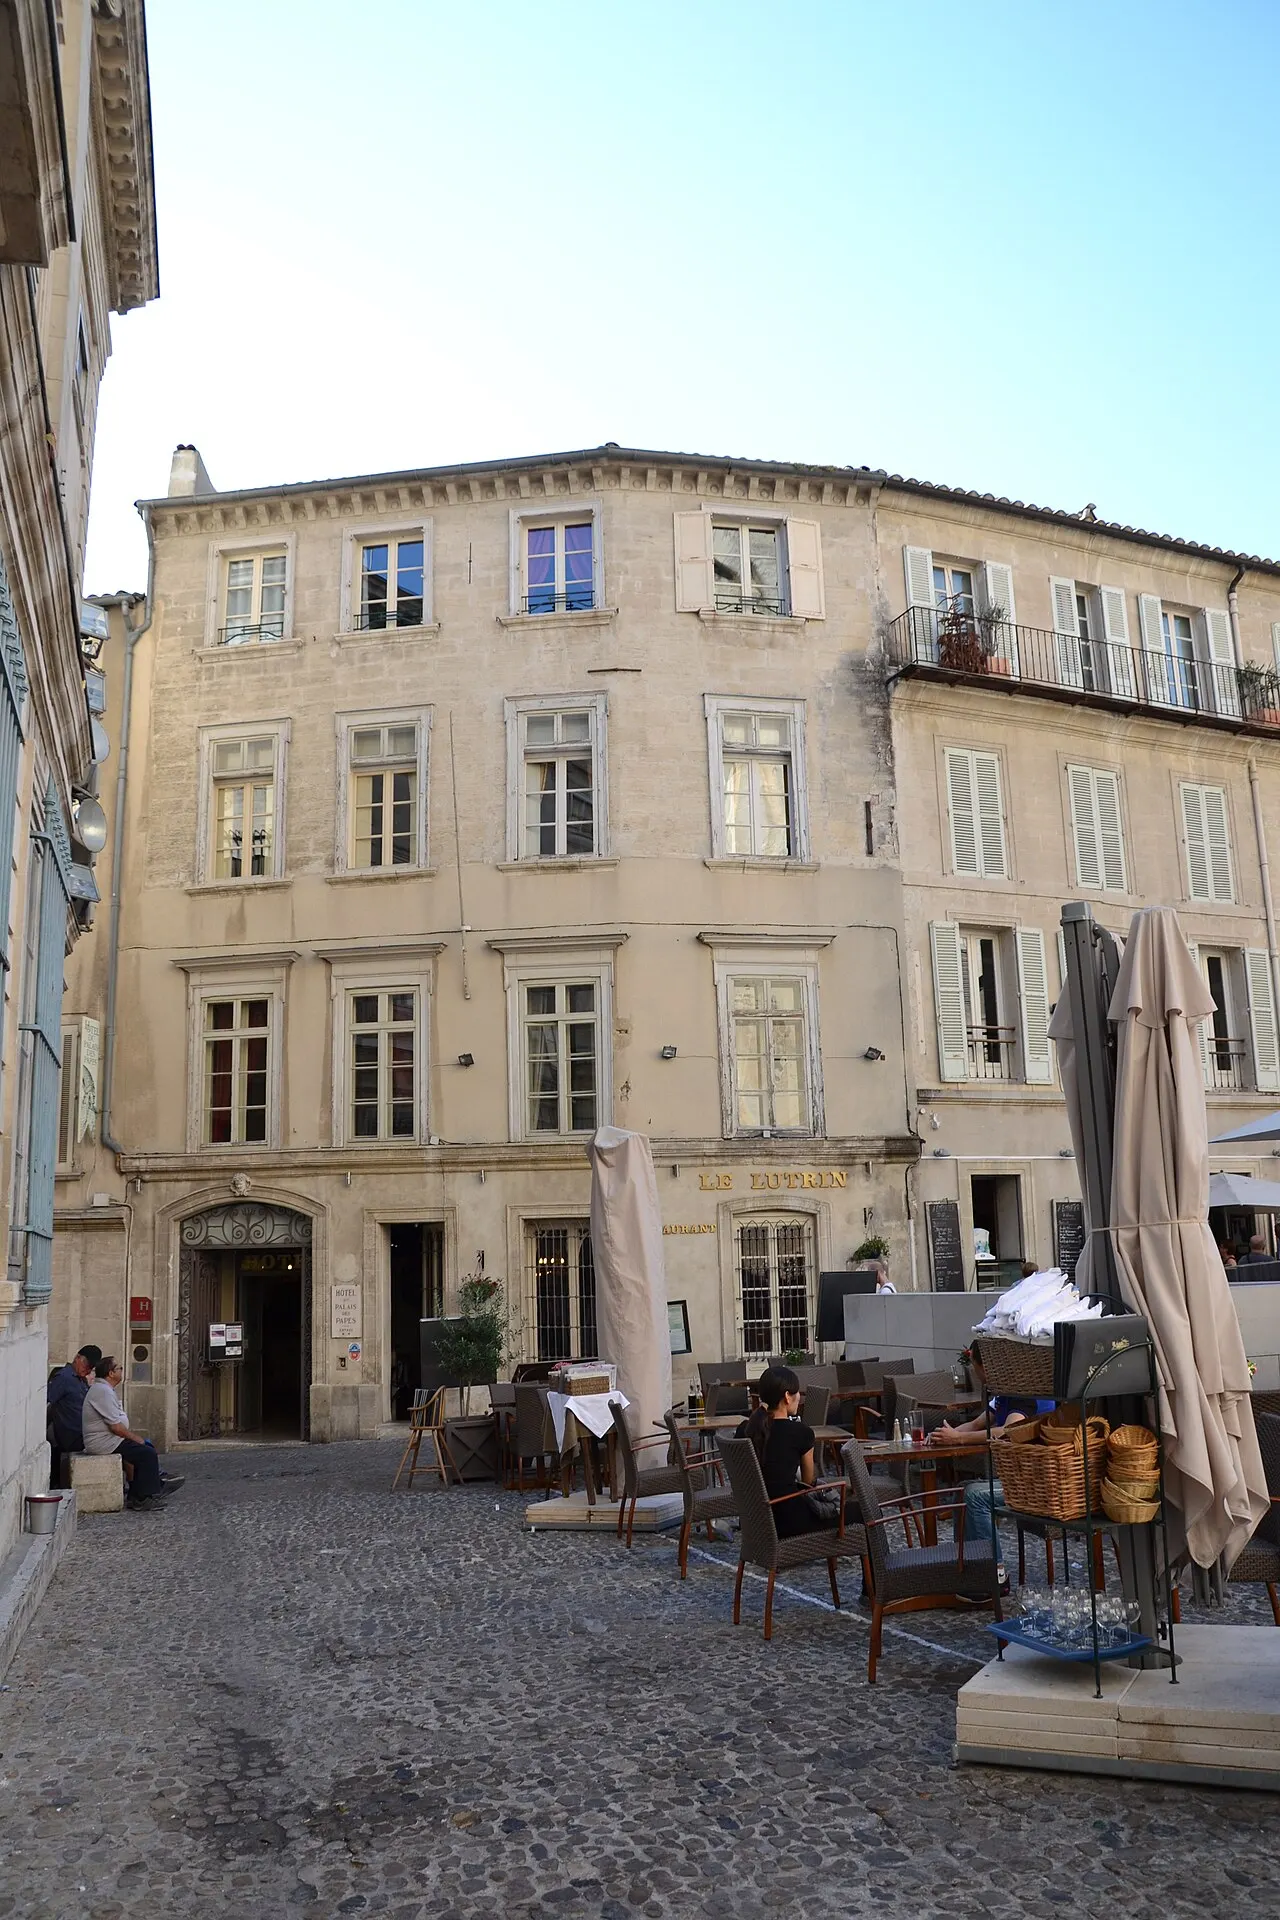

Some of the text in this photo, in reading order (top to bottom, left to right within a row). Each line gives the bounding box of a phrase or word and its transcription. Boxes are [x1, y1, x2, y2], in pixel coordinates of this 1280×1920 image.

[699, 1171, 848, 1190] LE LUTRIN
[139, 1301, 149, 1311] H
